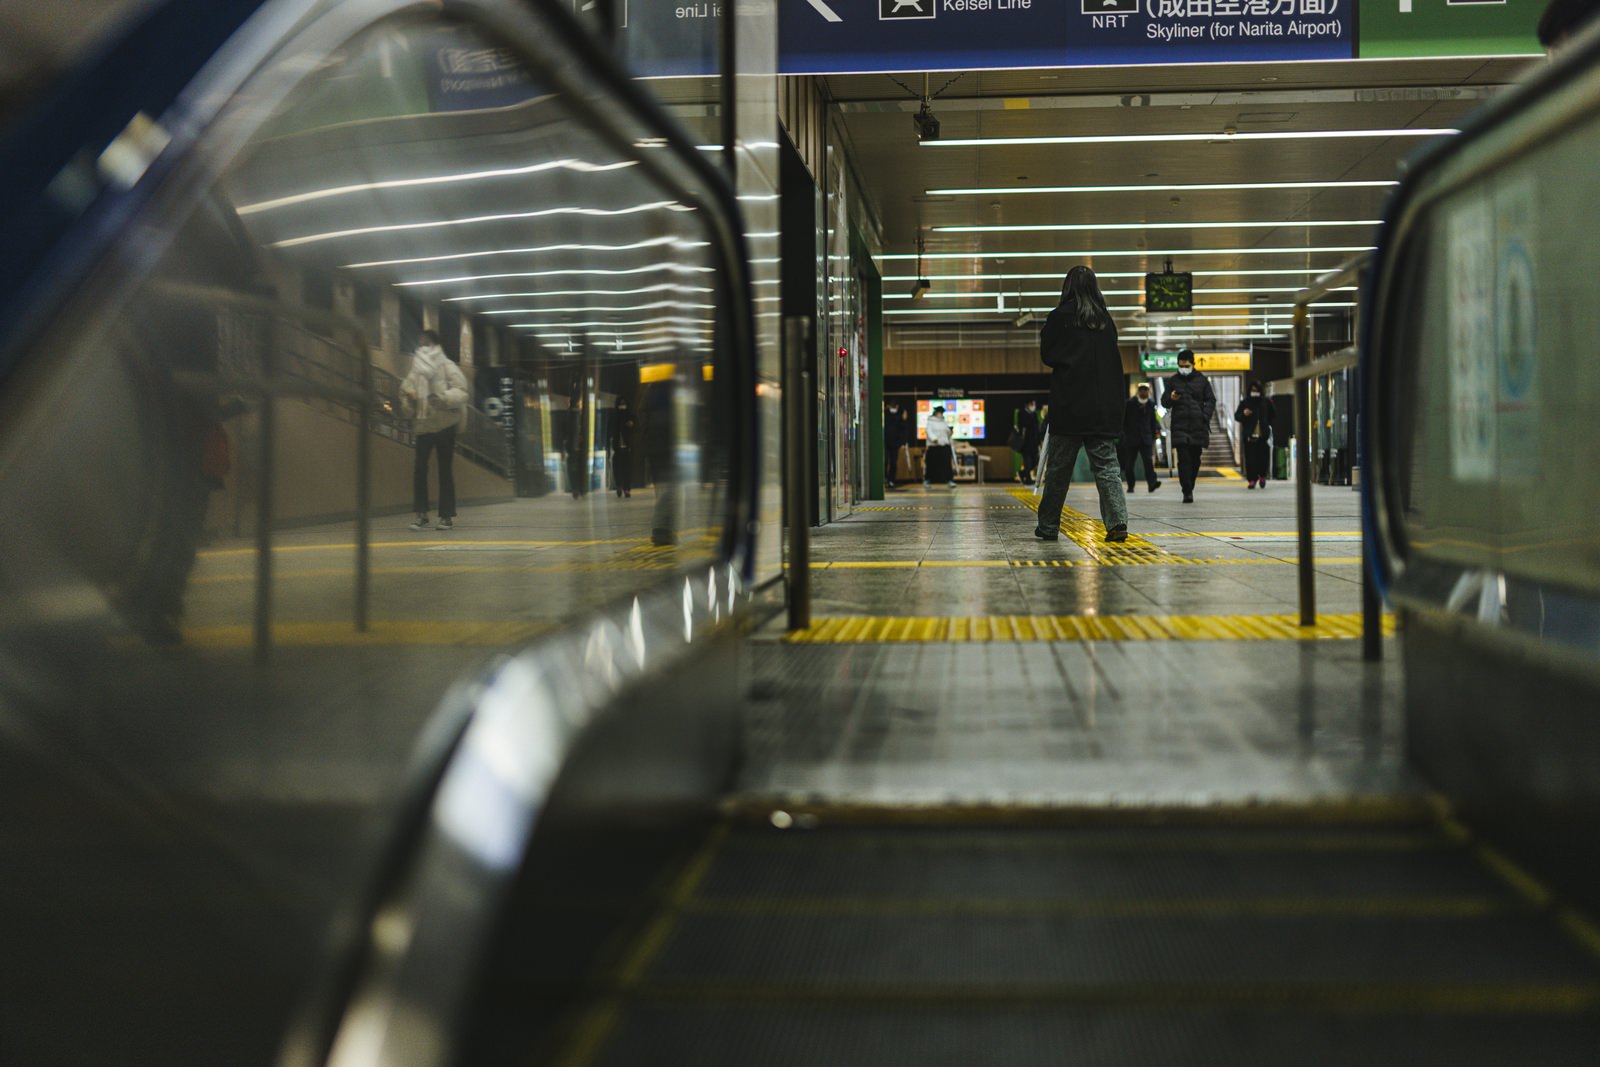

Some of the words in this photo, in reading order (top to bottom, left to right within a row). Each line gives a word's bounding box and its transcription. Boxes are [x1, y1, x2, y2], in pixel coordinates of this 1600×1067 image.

[997, 0, 1032, 9] Line
[1092, 15, 1129, 29] NRT
[1146, 23, 1205, 41] Skyliner
[1209, 22, 1235, 40] (for
[1239, 21, 1283, 36] Narita
[1287, 19, 1342, 38] Airport)
